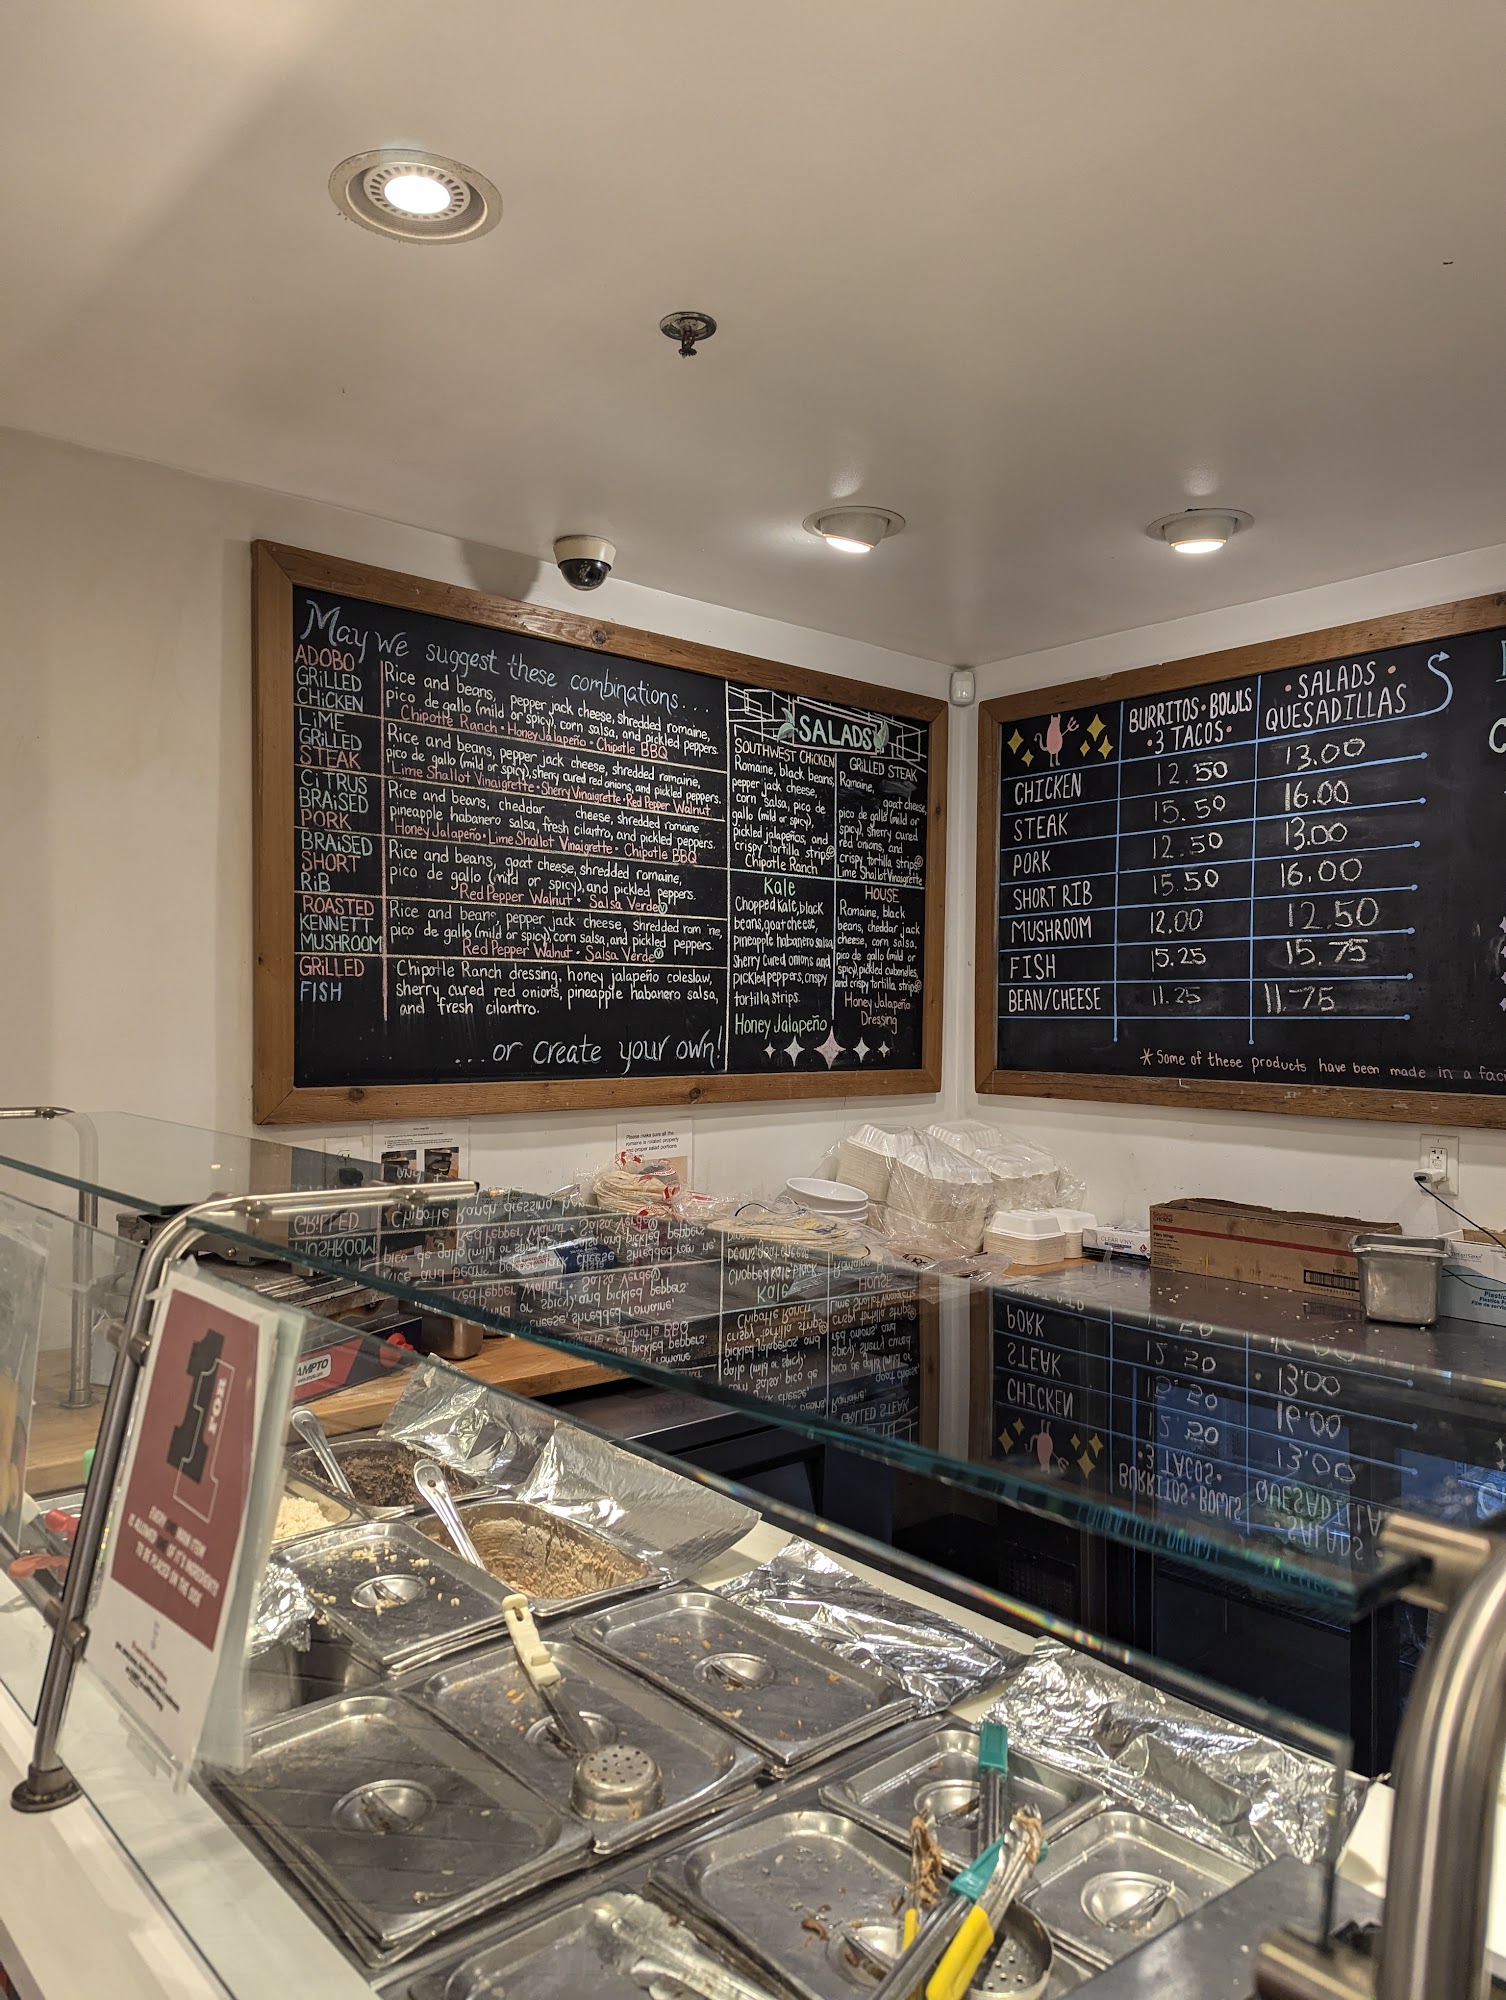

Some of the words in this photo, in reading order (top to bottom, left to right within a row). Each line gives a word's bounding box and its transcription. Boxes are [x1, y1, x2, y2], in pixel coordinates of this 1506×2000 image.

[295, 644, 355, 671] ADOBO
[300, 599, 368, 664] May
[426, 643, 500, 678] suggest
[507, 653, 558, 686] these
[1298, 661, 1375, 698] SALADS
[385, 661, 415, 685] Rice
[424, 675, 448, 691] and
[457, 675, 495, 701] beans,
[510, 695, 547, 713] pepper
[551, 696, 574, 716] jack
[578, 700, 615, 725] cheese,
[618, 713, 661, 731] shredded
[667, 722, 710, 742] romaine,
[1129, 697, 1199, 733] BURRITOS
[1209, 686, 1252, 719] BOWLS
[1266, 683, 1407, 732] QUESADILLAS
[387, 689, 415, 707] pico
[425, 693, 439, 709] de
[443, 701, 471, 718] gallo
[476, 700, 504, 718] (mild
[511, 712, 523, 721] or
[561, 720, 584, 732] corn
[589, 723, 618, 739] salsa,
[623, 729, 641, 742] and
[646, 733, 679, 750] pickled
[684, 739, 718, 757] peppers.
[401, 705, 453, 727] Chipotle
[460, 715, 497, 734] Ranch
[507, 722, 539, 742] Honey
[539, 728, 586, 747] Jalapeño
[597, 738, 635, 754] Chipotle
[641, 742, 669, 760] BBQ
[799, 715, 871, 750] SALADS
[1155, 730, 1165, 754] 3
[1172, 721, 1224, 751] TACOS
[300, 746, 360, 770] STEAK
[735, 737, 796, 762] SOUTHWEST
[888, 765, 917, 782] STEAK
[1014, 772, 1082, 806] CHICKEN
[1157, 761, 1228, 786] 12.50
[1286, 738, 1366, 770] 13.00
[301, 809, 352, 830] PORK
[1014, 813, 1068, 841] STEAK
[1154, 795, 1226, 824] 15.50
[1284, 780, 1352, 811] 16.00
[1013, 851, 1051, 876] PORK
[1153, 832, 1223, 859] 12.50
[1286, 817, 1348, 851] 13.00
[302, 851, 361, 873] SHORT
[745, 854, 786, 871] Chipotle
[790, 856, 818, 875] Ranch
[390, 866, 418, 884] pico
[427, 864, 443, 880] de
[451, 867, 481, 890] gallo
[528, 876, 541, 886] or
[587, 882, 608, 894] and
[614, 884, 650, 901] pickled
[658, 889, 696, 905] peppers.
[764, 877, 796, 896] Kale
[865, 886, 899, 903] HOUSE
[1013, 885, 1056, 911] SHORT
[1063, 881, 1092, 907] RIB
[1153, 869, 1219, 896] 15.50
[1281, 858, 1362, 887] 16.00
[303, 895, 374, 916] ROASTED
[1011, 916, 1092, 943] MUSHROOM
[1150, 909, 1203, 934] 12.00
[1289, 897, 1379, 929] 12.50
[300, 914, 373, 933] KENNETT
[301, 933, 382, 952] MUSHROOM
[1010, 954, 1056, 979] FISH
[1152, 947, 1206, 972] 15.25
[1286, 939, 1368, 966] 15.75
[397, 960, 455, 983] Chipotle
[462, 961, 502, 979] Ranch
[509, 963, 562, 986] dressing,
[568, 965, 604, 989] honey
[611, 968, 659, 987] jalapeño
[667, 969, 712, 985] coleslaw,
[301, 981, 342, 1002] FISH
[396, 980, 440, 1002] sherry
[448, 980, 484, 997] cured
[494, 982, 516, 998] red
[522, 986, 562, 1001] onions,
[568, 985, 623, 1010] pineapple
[630, 985, 681, 1000] habanero
[687, 986, 718, 1004] salsa,
[400, 1000, 425, 1015] and
[437, 998, 473, 1015] fresh
[486, 999, 540, 1015] cilantro.
[845, 992, 873, 1012] Honey
[875, 993, 911, 1016] Jalapeño
[1008, 988, 1101, 1012] BEAN/CHEESE
[1153, 986, 1201, 1007] 11.25
[1265, 983, 1335, 1014] 11.75
[735, 1013, 771, 1039] Honey
[774, 1014, 827, 1036] Jalapeño
[861, 1011, 897, 1034] Dressing
[533, 1034, 602, 1064] create
[620, 1035, 671, 1075] your
[677, 1026, 723, 1069] own!
[1157, 1049, 1185, 1066] Some
[1191, 1051, 1201, 1066] of
[1208, 1052, 1243, 1068] these
[1253, 1057, 1307, 1073] products
[1319, 1058, 1346, 1073] have
[1353, 1062, 1379, 1075] been
[1390, 1067, 1426, 1078] made
[1439, 1067, 1453, 1080] in
[1464, 1070, 1471, 1080] a
